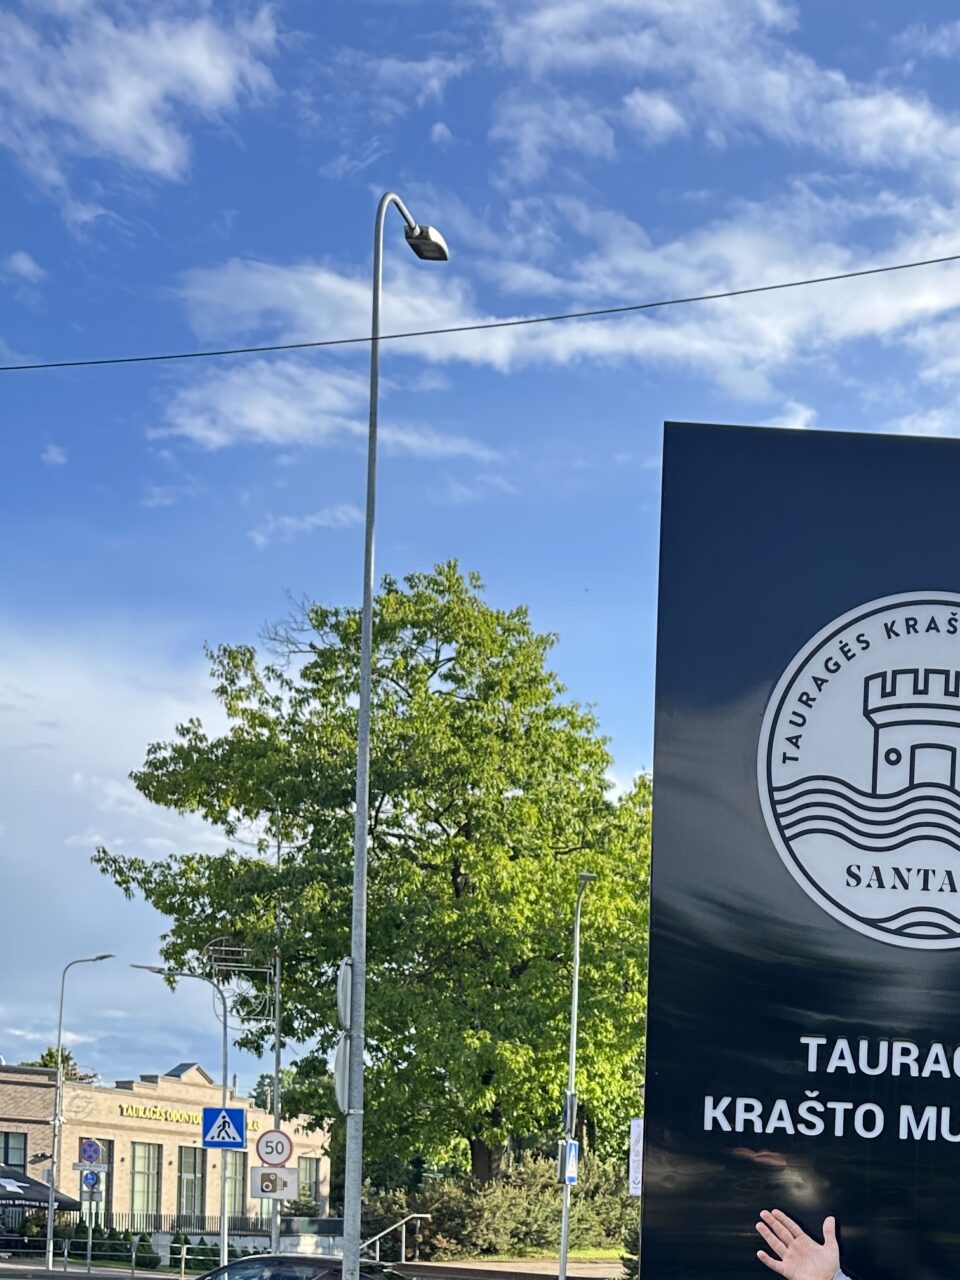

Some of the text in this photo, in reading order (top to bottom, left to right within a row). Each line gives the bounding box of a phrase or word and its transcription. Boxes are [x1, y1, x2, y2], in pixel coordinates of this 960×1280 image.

[782, 633, 871, 764] TAURAGĖS
[703, 1090, 885, 1139] KRAŠTO
[265, 1141, 284, 1155] 50
